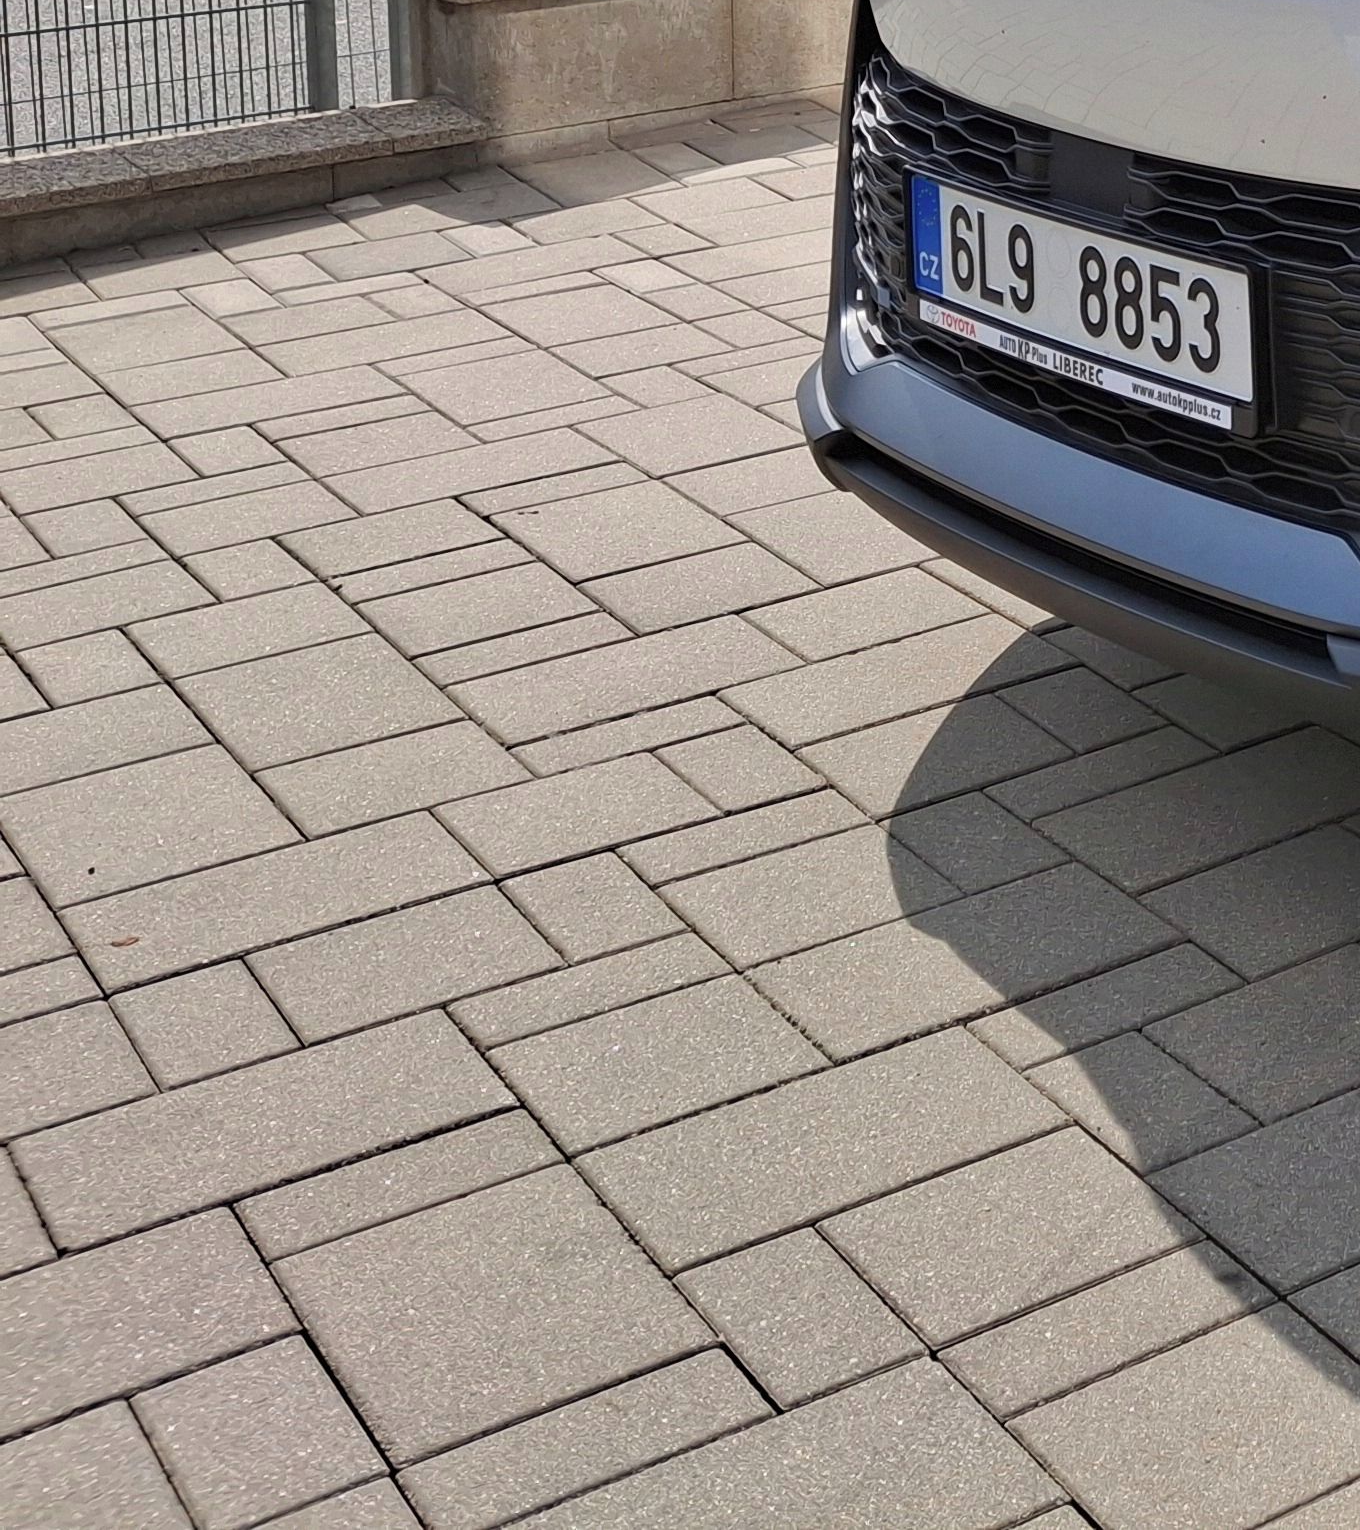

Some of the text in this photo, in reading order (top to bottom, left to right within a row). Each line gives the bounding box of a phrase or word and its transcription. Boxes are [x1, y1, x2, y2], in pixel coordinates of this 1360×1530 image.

[918, 250, 940, 281] CZ
[950, 203, 1221, 374] 6L9 8853
[940, 311, 977, 339] TOYOTA
[999, 334, 1017, 354] AUTO
[1017, 338, 1031, 362] KP
[1052, 352, 1105, 387] LIBEREC
[1130, 381, 1222, 422] www.autokpplus.cz
